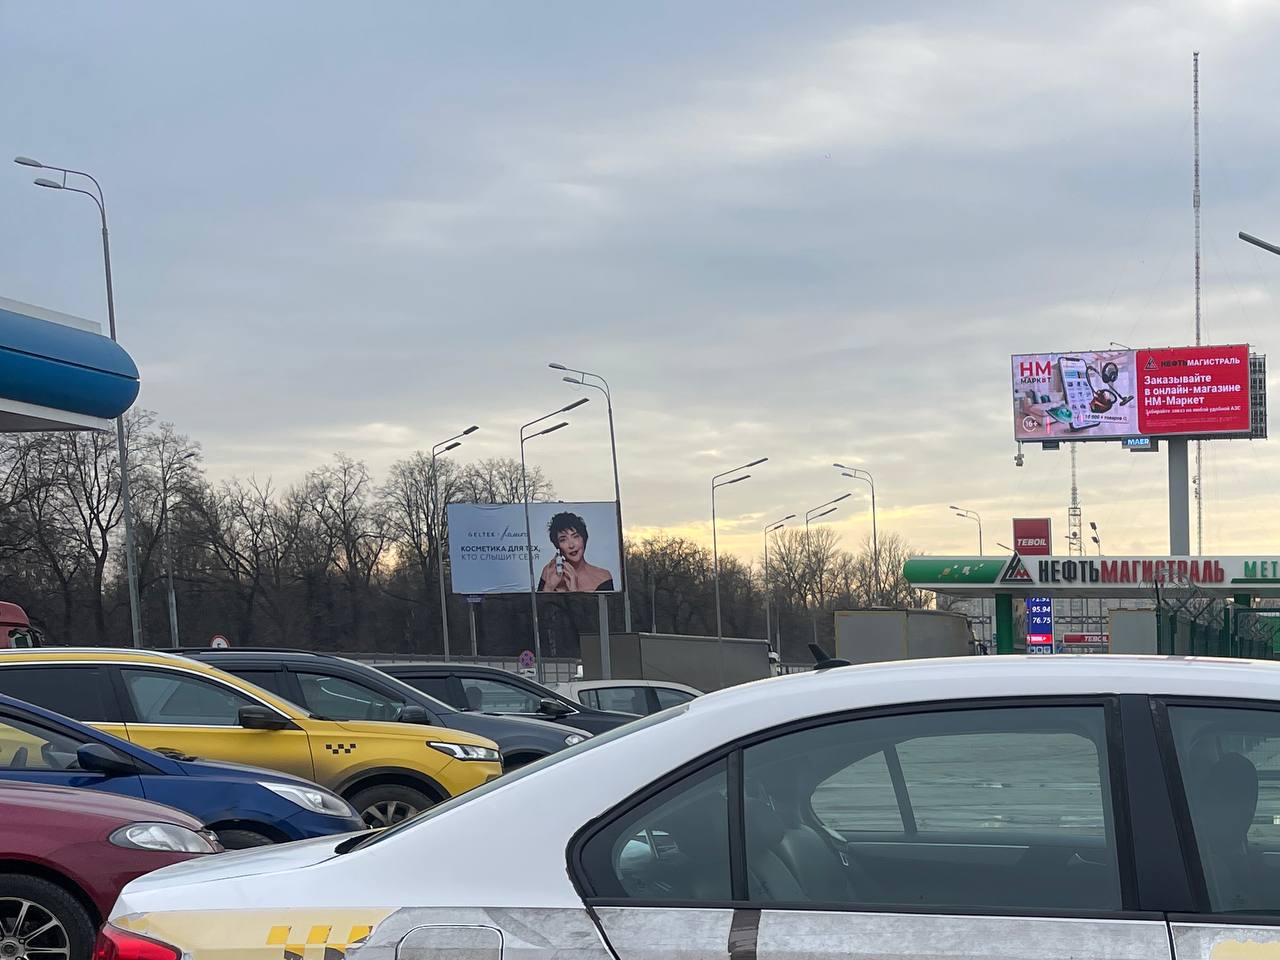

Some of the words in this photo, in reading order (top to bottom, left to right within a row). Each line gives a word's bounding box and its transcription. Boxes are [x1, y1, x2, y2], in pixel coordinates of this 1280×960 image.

[1144, 373, 1212, 385] Заказывайте
[1144, 388, 1151, 396] в
[1153, 384, 1241, 395] онлайн-магазине
[1144, 396, 1205, 407] НМ-Маркет
[1025, 419, 1038, 427] 16+
[1017, 538, 1048, 546] TEBOIL
[508, 545, 524, 553] ДЛЯ
[1038, 559, 1225, 584] НЕФТЬМАГИСТРАЛЬ
